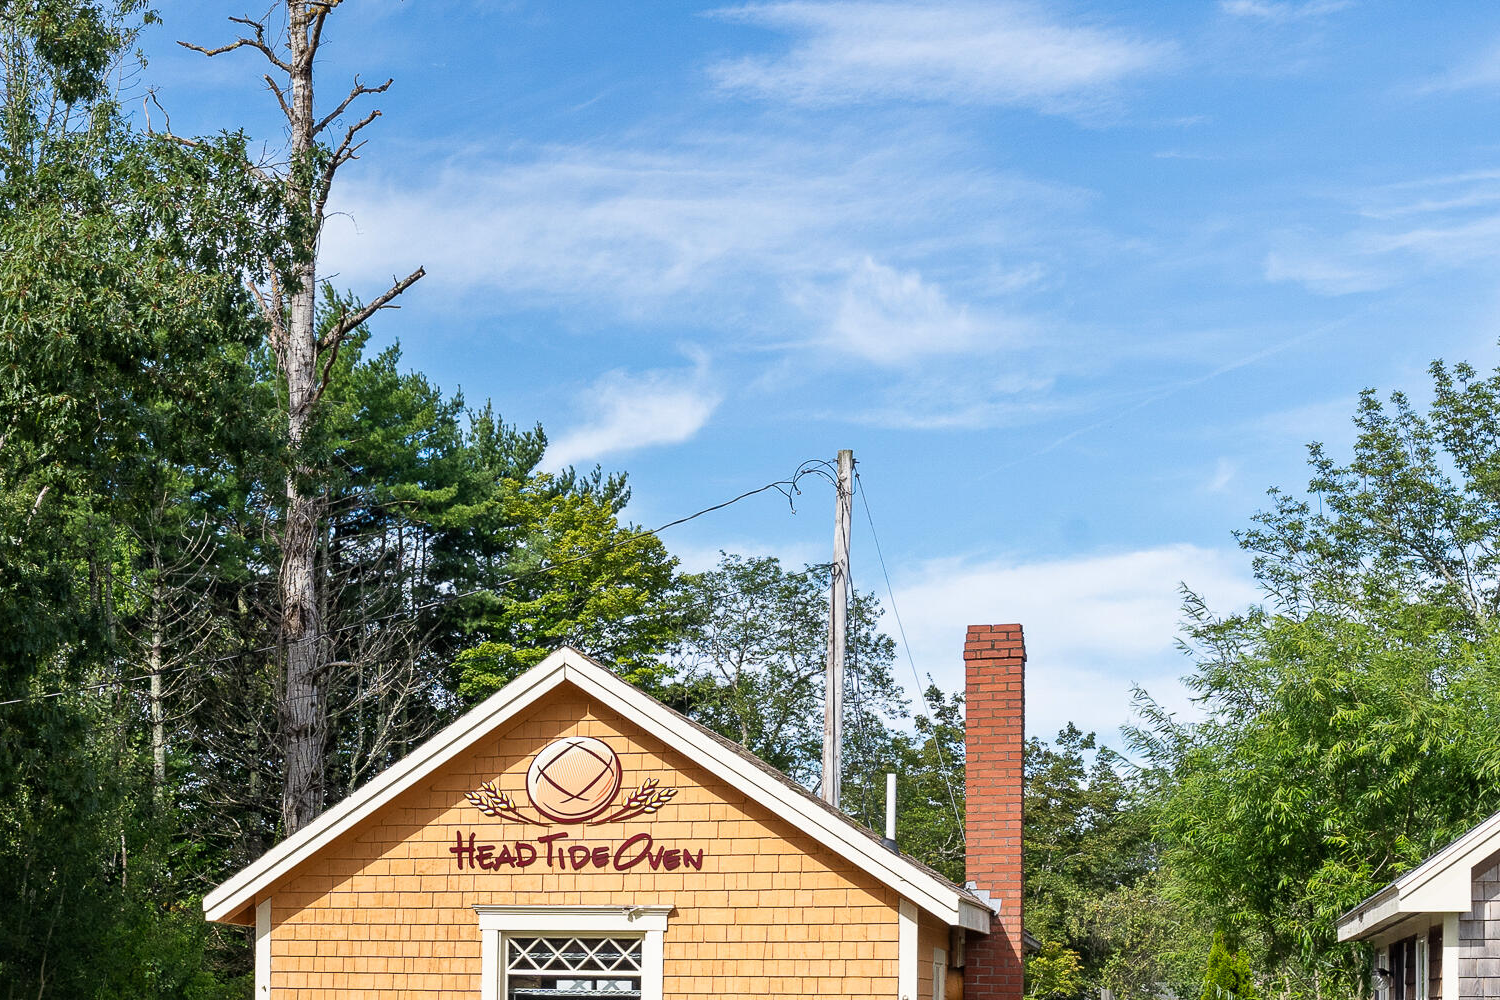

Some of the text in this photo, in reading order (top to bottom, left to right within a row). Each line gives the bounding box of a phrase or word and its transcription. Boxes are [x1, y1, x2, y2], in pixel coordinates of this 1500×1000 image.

[449, 830, 703, 872] HEAD TIDE OVEN
